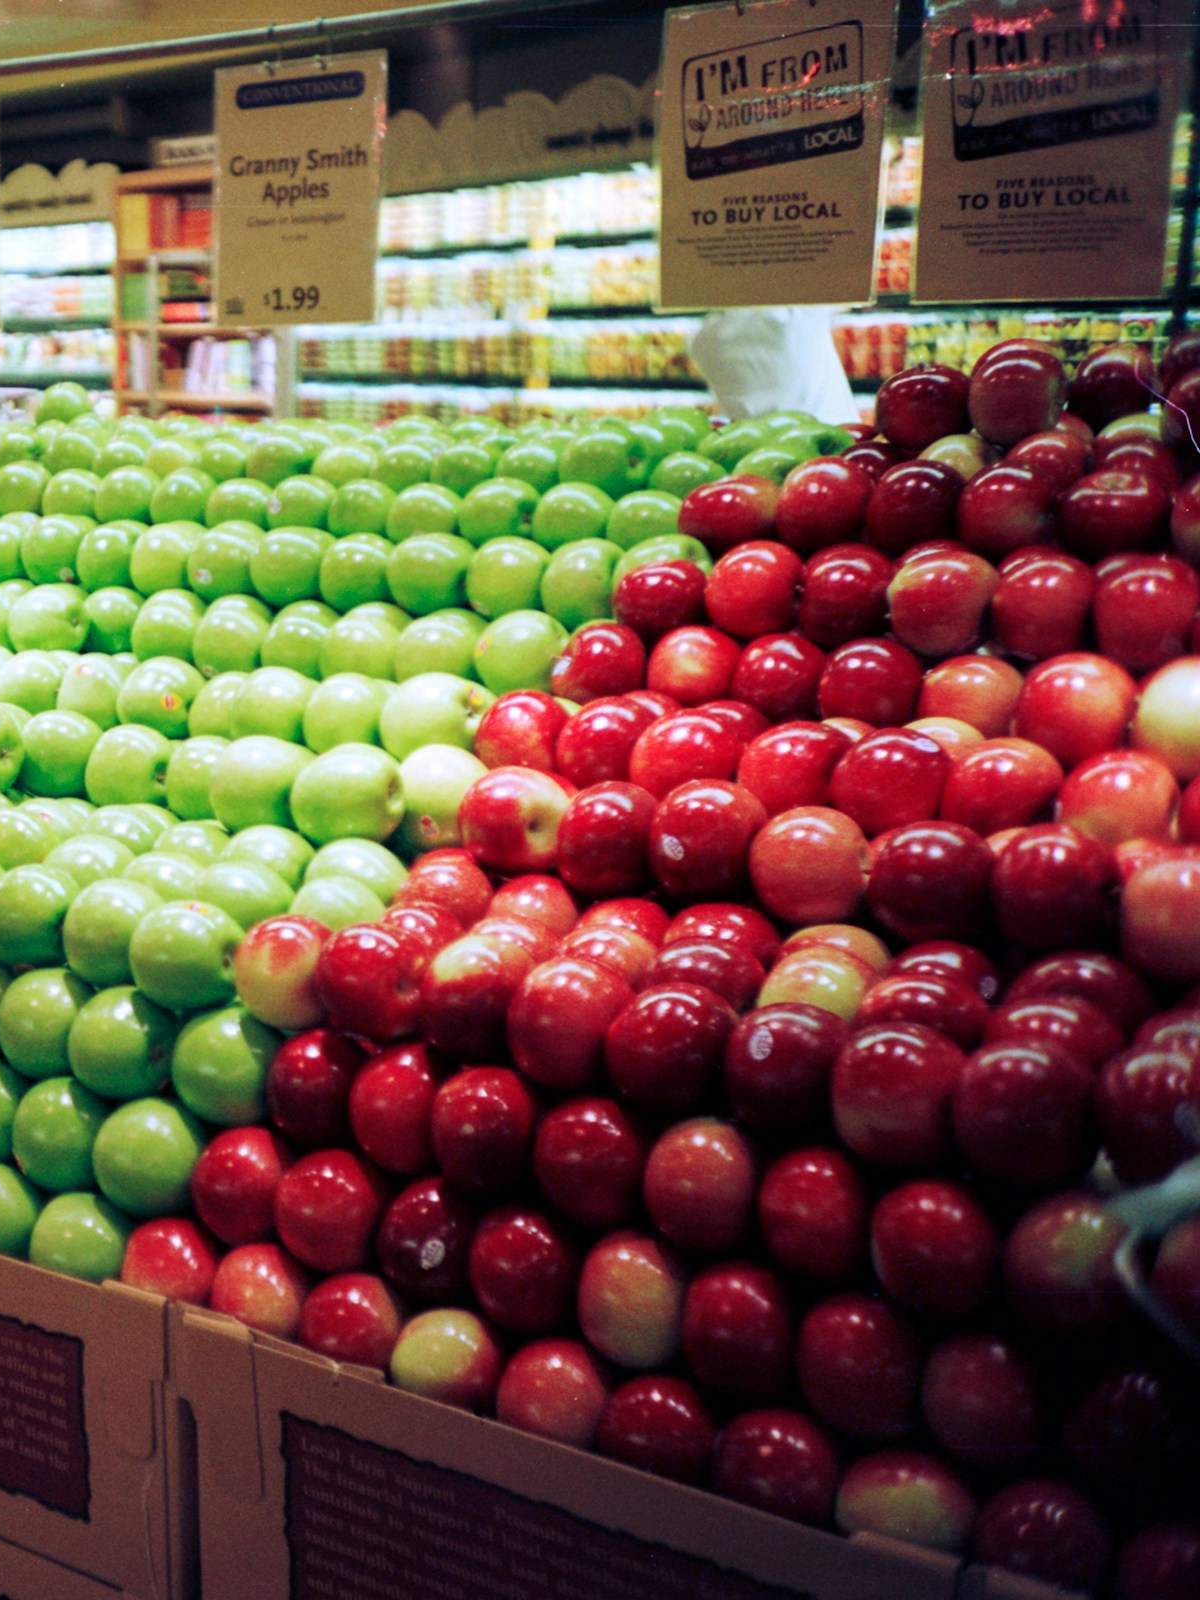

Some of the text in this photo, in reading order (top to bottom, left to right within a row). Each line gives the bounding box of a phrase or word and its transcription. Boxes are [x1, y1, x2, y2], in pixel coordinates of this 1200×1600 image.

[966, 33, 1027, 76] I'M
[696, 43, 847, 101] I'M FROM
[716, 94, 793, 130] AROUND
[804, 125, 858, 149] LOCAL
[230, 145, 367, 178] Granny Smith
[262, 177, 329, 205] Apples
[958, 185, 1132, 211] TO BUY LOCAL
[691, 202, 842, 226] TO BUY LOCAL
[264, 285, 321, 311] $1.99
